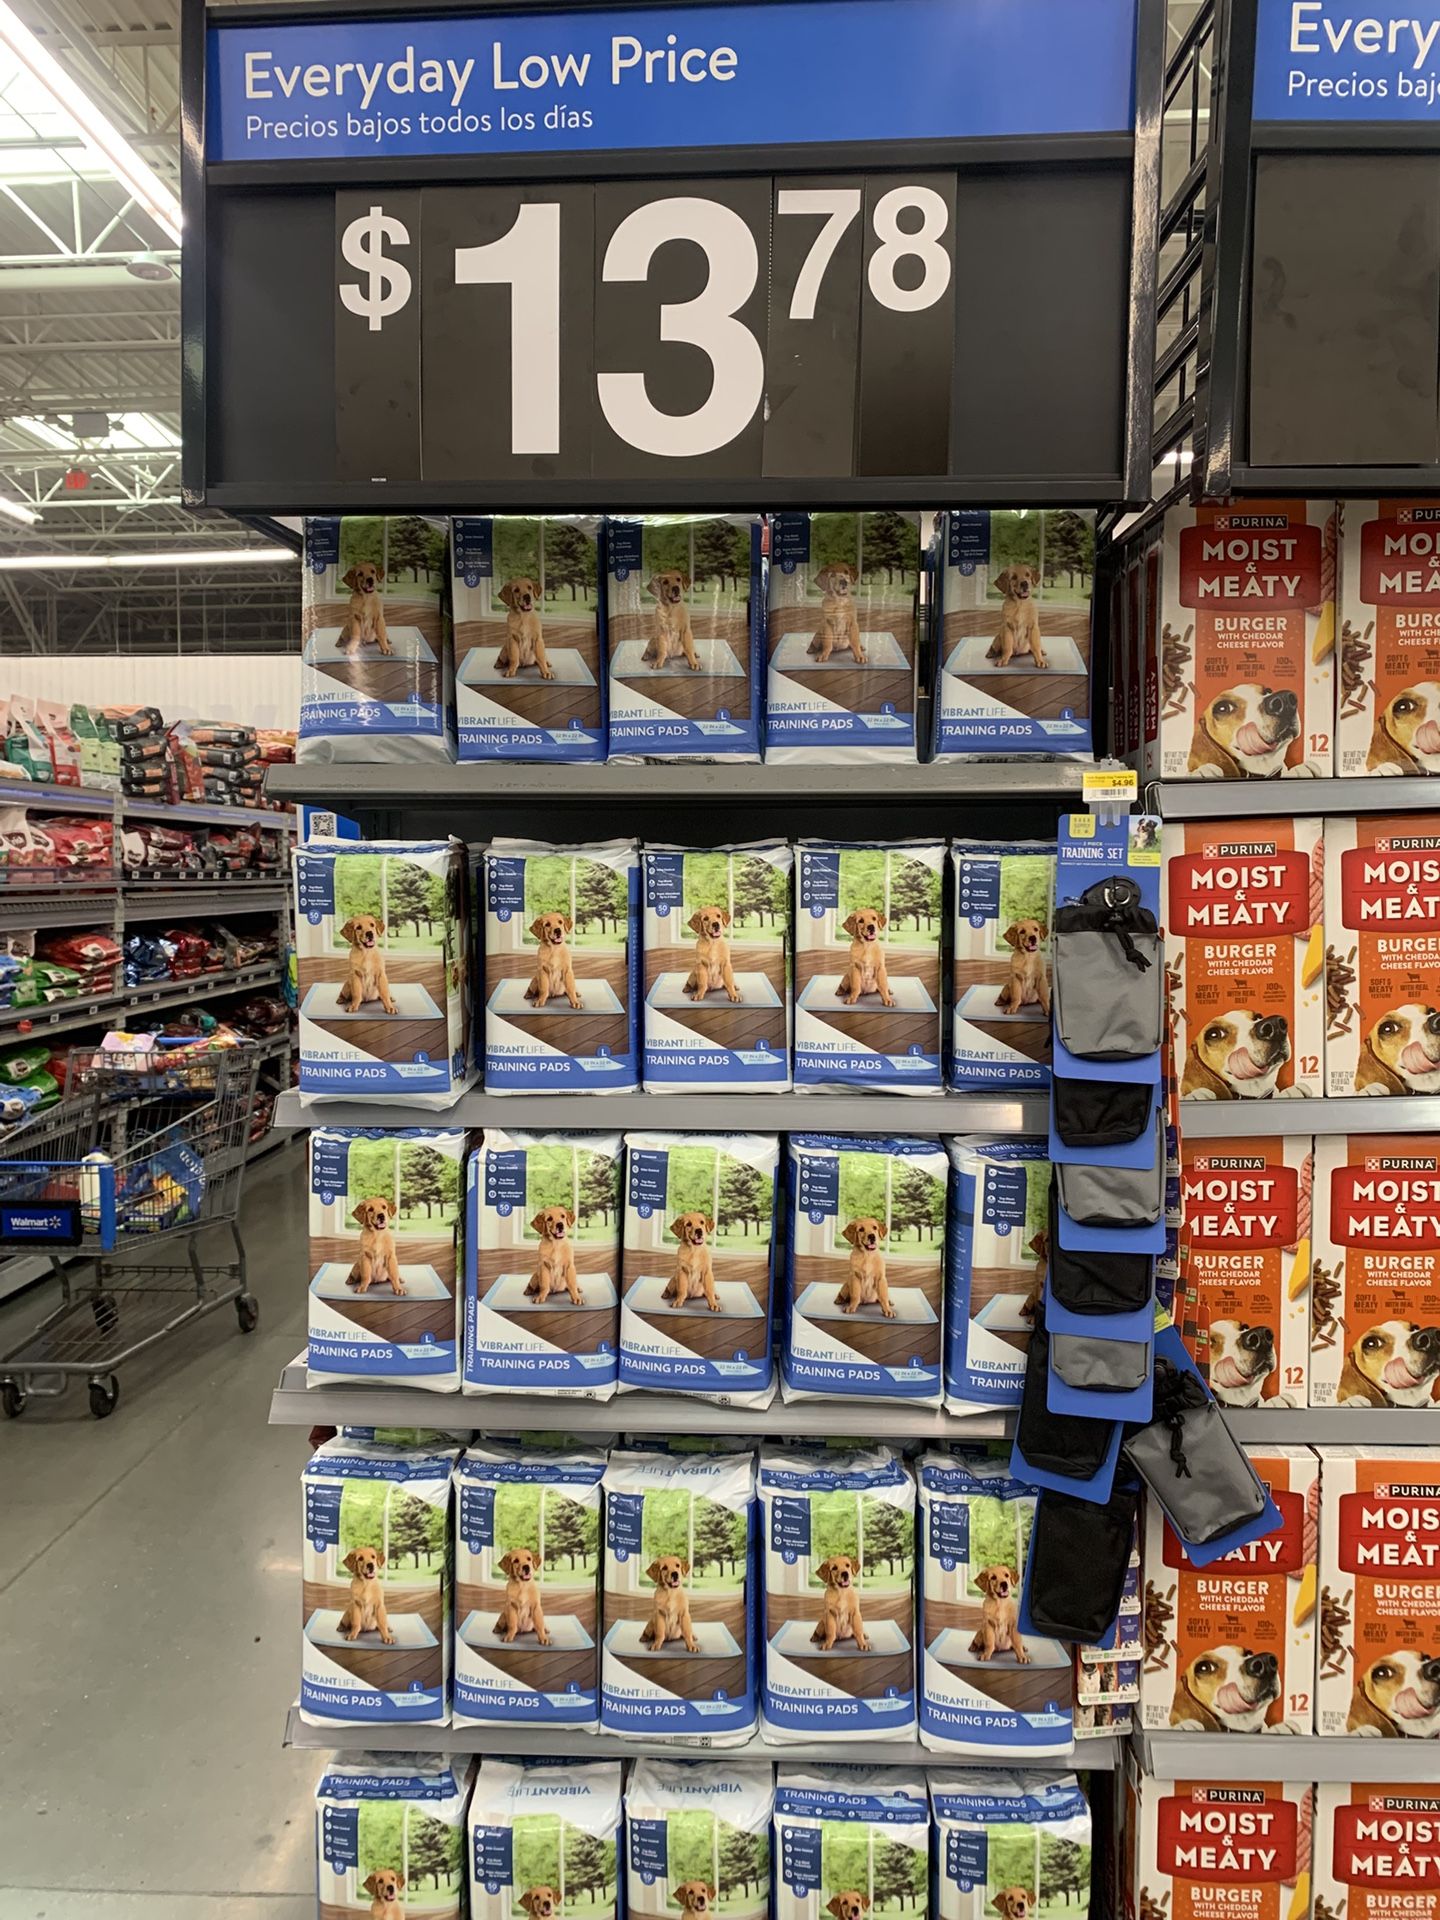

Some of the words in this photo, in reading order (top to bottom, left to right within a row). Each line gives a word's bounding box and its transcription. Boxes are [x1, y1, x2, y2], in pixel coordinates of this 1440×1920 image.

[243, 45, 475, 108] Everyday
[492, 40, 592, 90] Low
[611, 33, 738, 84] Price
[1288, 71, 1388, 97] Precios
[245, 114, 338, 140] Precios
[345, 110, 412, 142] bajos
[419, 108, 491, 133] todos
[499, 106, 537, 130] los
[543, 102, 593, 130] días
[1232, 517, 1283, 527] PURINA
[1203, 539, 1297, 561] MOIST
[1245, 562, 1257, 573] &
[1198, 575, 1300, 597] MEATY
[1214, 617, 1287, 631] BURGER
[1217, 641, 1249, 649] CHEESE
[768, 702, 807, 711] VIBRANT
[808, 702, 826, 710] LIFE
[658, 726, 688, 736] PADS
[768, 720, 818, 729] TRAINING
[822, 720, 853, 729] PADS
[942, 726, 996, 735] TRAINING
[1000, 726, 1032, 735] PADS
[458, 734, 508, 744] TRAINING
[512, 735, 542, 744] PADS
[1309, 734, 1329, 752] 12
[1061, 847, 1104, 859] TRAINING
[1107, 848, 1123, 859] SET
[1221, 845, 1272, 855] PURINA
[1191, 866, 1286, 889] MOIST
[1364, 860, 1439, 883] MOIS
[1234, 890, 1246, 901] &
[1407, 884, 1418, 894] &
[1188, 902, 1289, 925] MEATY
[1361, 897, 1440, 919] MEAT
[1204, 944, 1277, 958] BURGER
[1232, 959, 1272, 967] CHEDDAR
[301, 1050, 339, 1059] VIBRANT
[341, 1052, 360, 1060] LIFE
[647, 1056, 695, 1065] TRAINING
[699, 1056, 729, 1065] PADS
[488, 1062, 536, 1072] TRAINING
[540, 1063, 570, 1072] PADS
[797, 1058, 847, 1069] TRAINING
[851, 1060, 881, 1069] PADS
[1300, 1056, 1318, 1073] 12
[301, 1066, 351, 1078] TRAINING
[355, 1068, 386, 1078] PADS
[955, 1065, 1006, 1077] TRAINING
[1010, 1069, 1040, 1078] PADS
[1212, 1159, 1262, 1168] PURINA
[1383, 1160, 1433, 1169] PURINA
[1185, 1180, 1274, 1201] MOIST
[1224, 1202, 1236, 1213] &
[1395, 1203, 1406, 1213] &
[11, 1217, 48, 1226] Walmart
[1194, 1256, 1264, 1269] BURGER
[1364, 1256, 1435, 1270] BURGER
[309, 1343, 358, 1358] TRAINING
[361, 1349, 392, 1358] PADS
[466, 1326, 474, 1372] TRAINING
[481, 1341, 523, 1350] VIBRANT
[526, 1342, 544, 1351] LIFE
[602, 1344, 607, 1352] L
[480, 1358, 535, 1369] TRAINING
[539, 1360, 570, 1369] PADS
[621, 1356, 670, 1372] TRAINING
[674, 1364, 706, 1374] PADS
[970, 1360, 1017, 1371] VIBRANT
[792, 1362, 844, 1378] TRAINING
[848, 1370, 880, 1380] PADS
[1285, 1367, 1303, 1384] 12
[1362, 1507, 1439, 1530] MOIS
[1405, 1531, 1417, 1542] &
[1358, 1543, 1439, 1566] MEAT
[1197, 1580, 1269, 1594] BURGER
[770, 1682, 812, 1696] VIBRANT
[814, 1688, 832, 1696] LIFE
[304, 1686, 348, 1704] TRAINING
[352, 1697, 382, 1706] PADS
[457, 1688, 505, 1705] TRAINING
[509, 1698, 539, 1707] PADS
[927, 1690, 968, 1707] VIBRANT
[971, 1700, 990, 1708] LIFE
[602, 1699, 651, 1715] TRAINING
[655, 1706, 686, 1715] PADS
[770, 1698, 823, 1714] TRAINING
[827, 1705, 858, 1714] PADS
[1289, 1694, 1308, 1712] 12
[927, 1706, 981, 1725] TRAINING
[986, 1718, 1017, 1727] PADS
[330, 1777, 380, 1787] TRAINING
[382, 1778, 410, 1787] PADS
[784, 1790, 835, 1804] TRAINING
[838, 1796, 867, 1805] PADS
[1210, 1791, 1261, 1802] PURINA
[1387, 1800, 1438, 1810] PURINA
[1180, 1810, 1273, 1835] MOIST
[1222, 1835, 1233, 1846] &
[1399, 1843, 1409, 1853] &
[1176, 1845, 1276, 1870] MEATY
[1191, 1887, 1262, 1902] BURGER
[1218, 1903, 1258, 1911] CHEDDAR
[1366, 1895, 1437, 1908] BURGER
[1193, 1911, 1224, 1919] CHEESE
